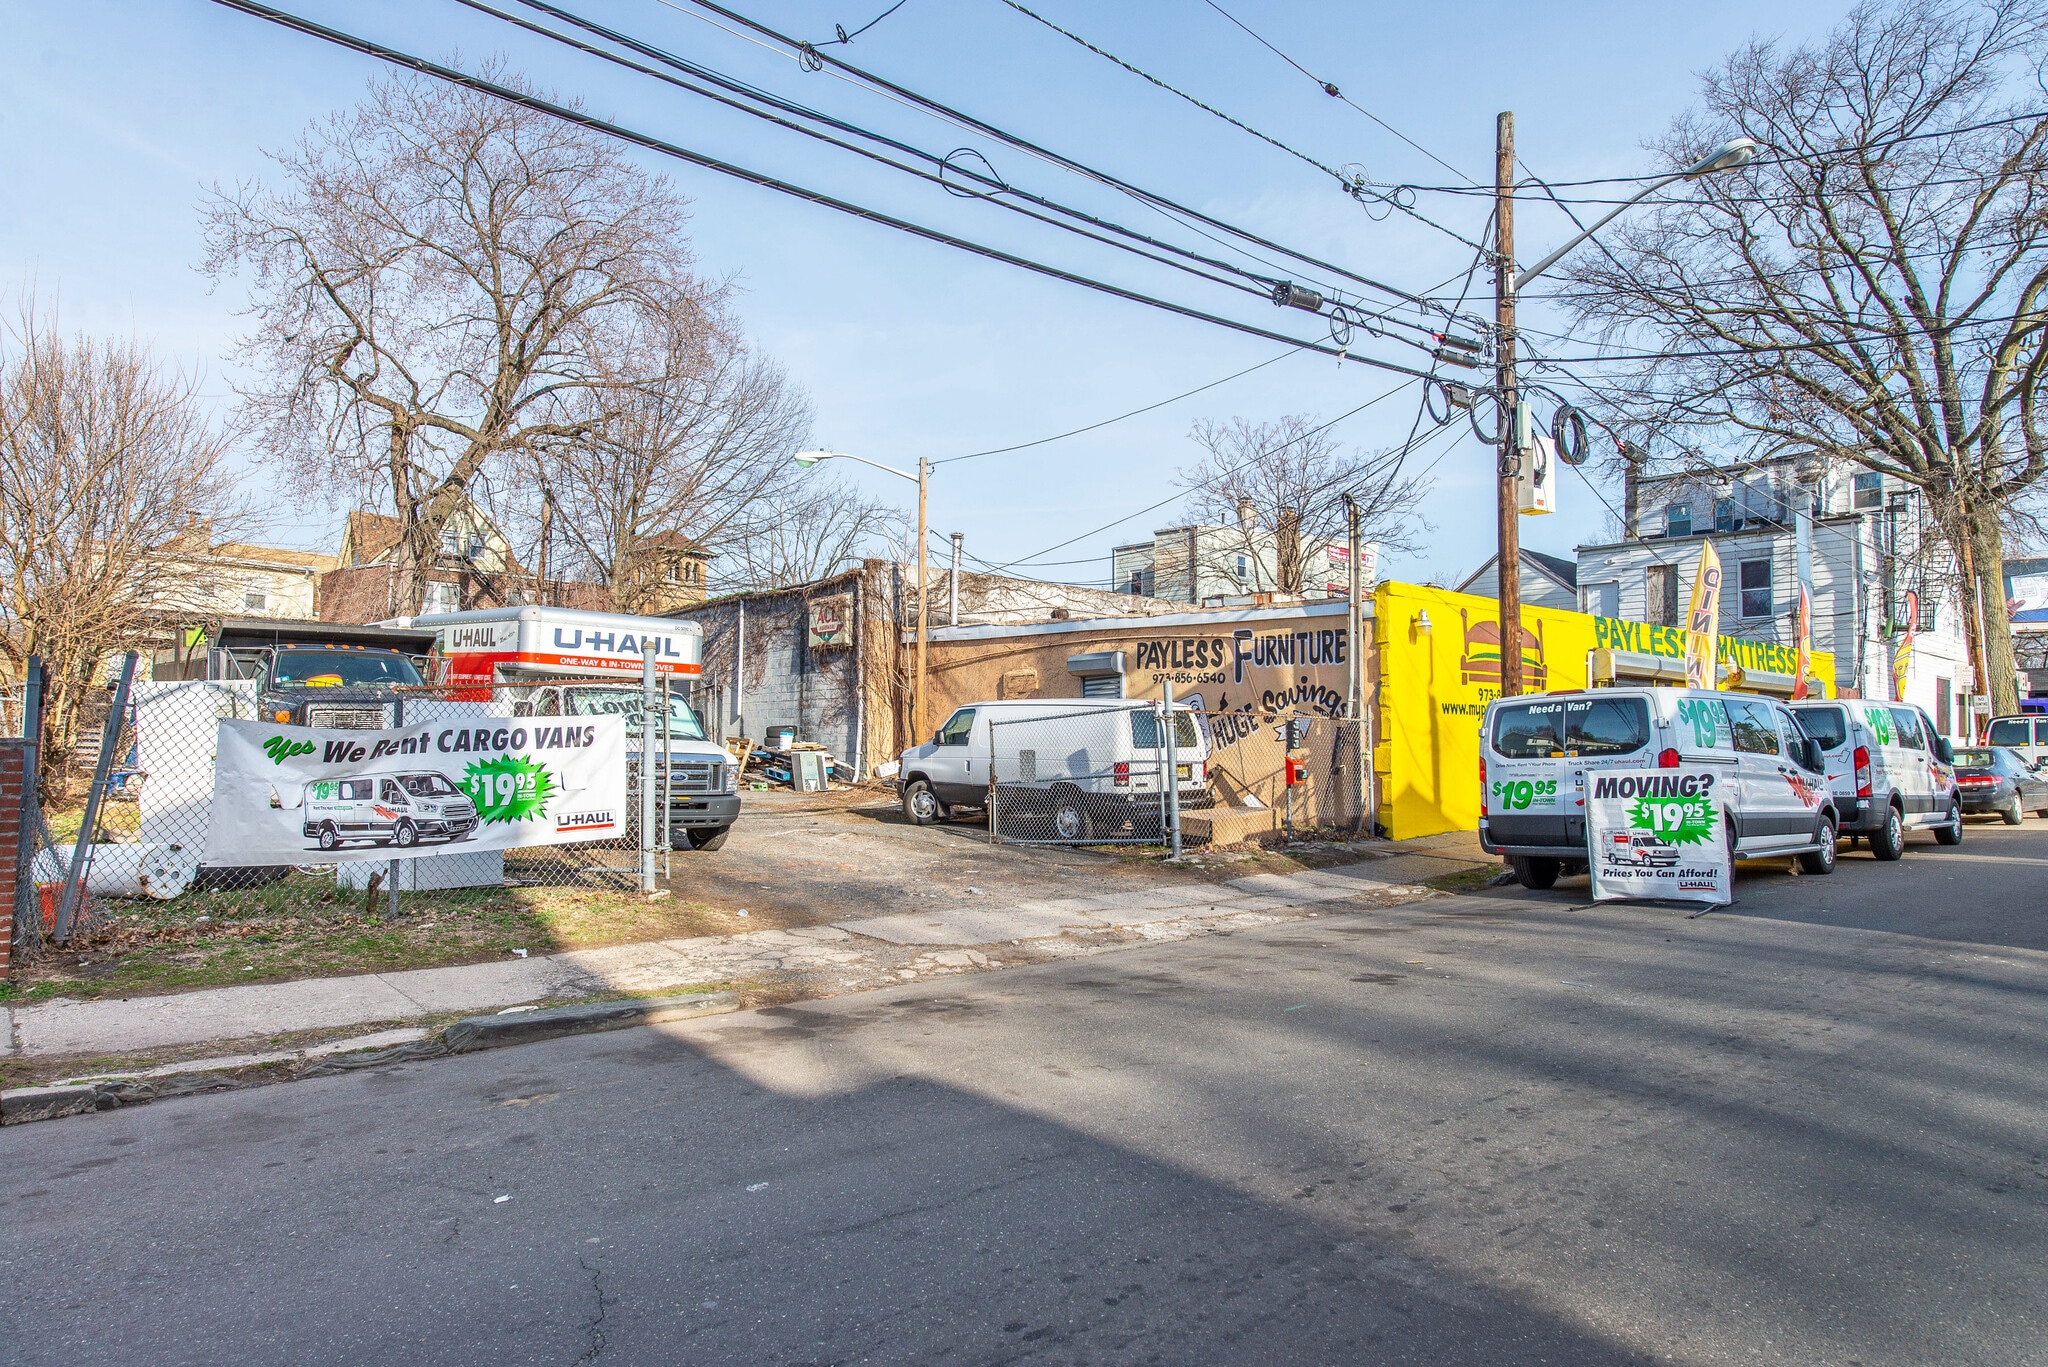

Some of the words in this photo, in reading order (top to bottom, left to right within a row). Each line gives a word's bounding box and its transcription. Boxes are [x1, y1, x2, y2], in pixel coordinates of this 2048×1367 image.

[453, 627, 496, 647] U-HAUL
[554, 628, 680, 657] U-HAUL
[560, 657, 599, 667] ONE-WAY
[600, 659, 607, 667] &
[609, 661, 644, 669] IN-TOWN
[655, 664, 674, 672] OVES
[1137, 639, 1224, 669] PAYLESS
[1232, 629, 1348, 684] FURNITURE
[1718, 634, 1798, 675] MATTRESS
[1212, 703, 1259, 751] HUGE
[1263, 675, 1348, 723] Savings
[1441, 702, 1487, 721] www.myp
[1529, 704, 1554, 714] Need
[1567, 701, 1592, 711] Van?
[263, 735, 316, 765] Yes
[323, 741, 366, 763] We
[369, 732, 431, 760] Rent
[437, 728, 528, 752] CARGO
[535, 726, 595, 749] VANS
[1594, 773, 1715, 799] MOVING?
[557, 812, 614, 826] U-HAUL
[1603, 869, 1632, 877] Prices
[1635, 869, 1653, 877] You
[1656, 869, 1675, 877] Can
[1678, 868, 1718, 878] Afford!
